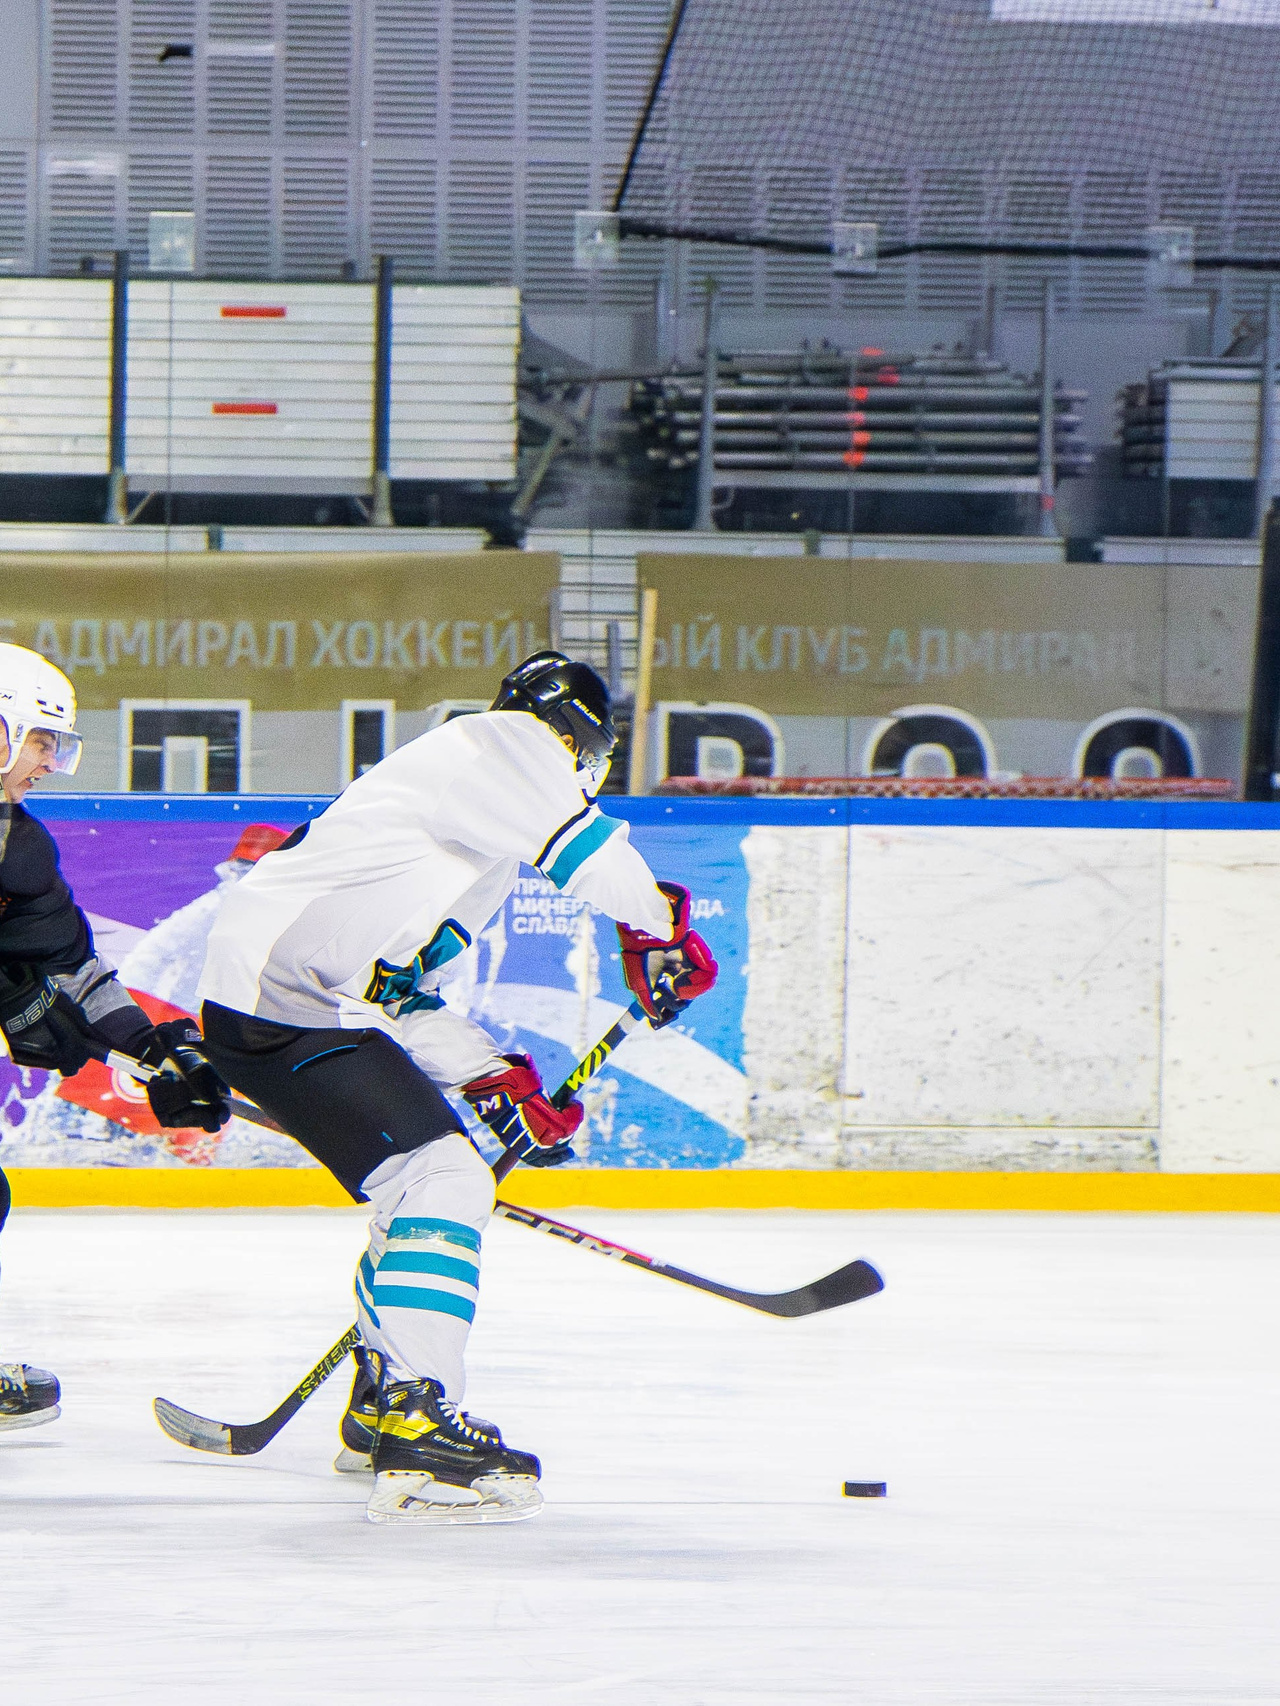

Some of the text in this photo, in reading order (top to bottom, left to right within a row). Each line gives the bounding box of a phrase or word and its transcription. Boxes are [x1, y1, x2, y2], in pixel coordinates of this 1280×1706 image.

[34, 618, 299, 676] АДМИРАЛ
[736, 624, 868, 673] КЛУБ
[6, 975, 60, 1034] BAU
[297, 1322, 362, 1402] SHER
